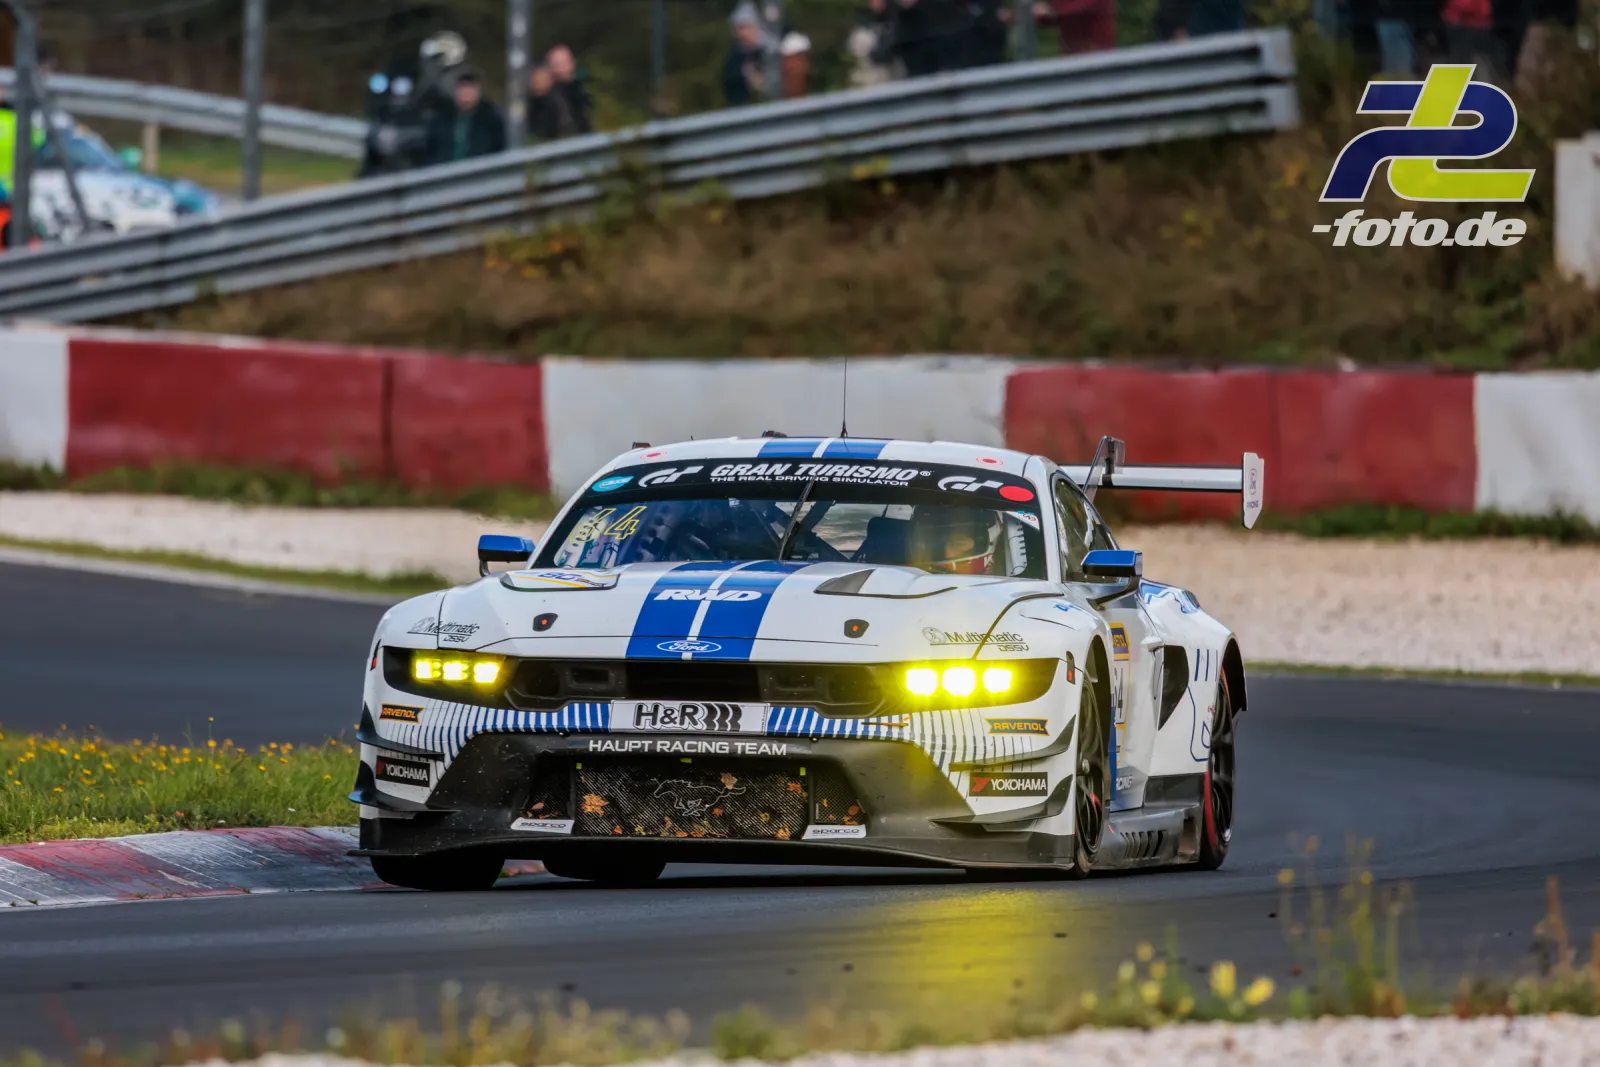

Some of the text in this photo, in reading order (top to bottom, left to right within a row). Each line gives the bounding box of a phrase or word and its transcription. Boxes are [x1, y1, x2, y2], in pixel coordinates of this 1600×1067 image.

[710, 464, 792, 477] GRAN
[832, 476, 909, 487] SIMULATOR
[653, 589, 763, 602] RWD
[944, 630, 1024, 643] Multimatic
[668, 641, 708, 652] Ford
[998, 644, 1030, 652] DSSV
[382, 707, 416, 719] RAVENOL
[634, 702, 703, 730] H&R
[993, 722, 1045, 731] RAVENOL
[589, 740, 786, 755] HAUPT RACING TEAM
[385, 763, 429, 781] YOKOHAMA
[991, 778, 1047, 791] YOKOHAMA
